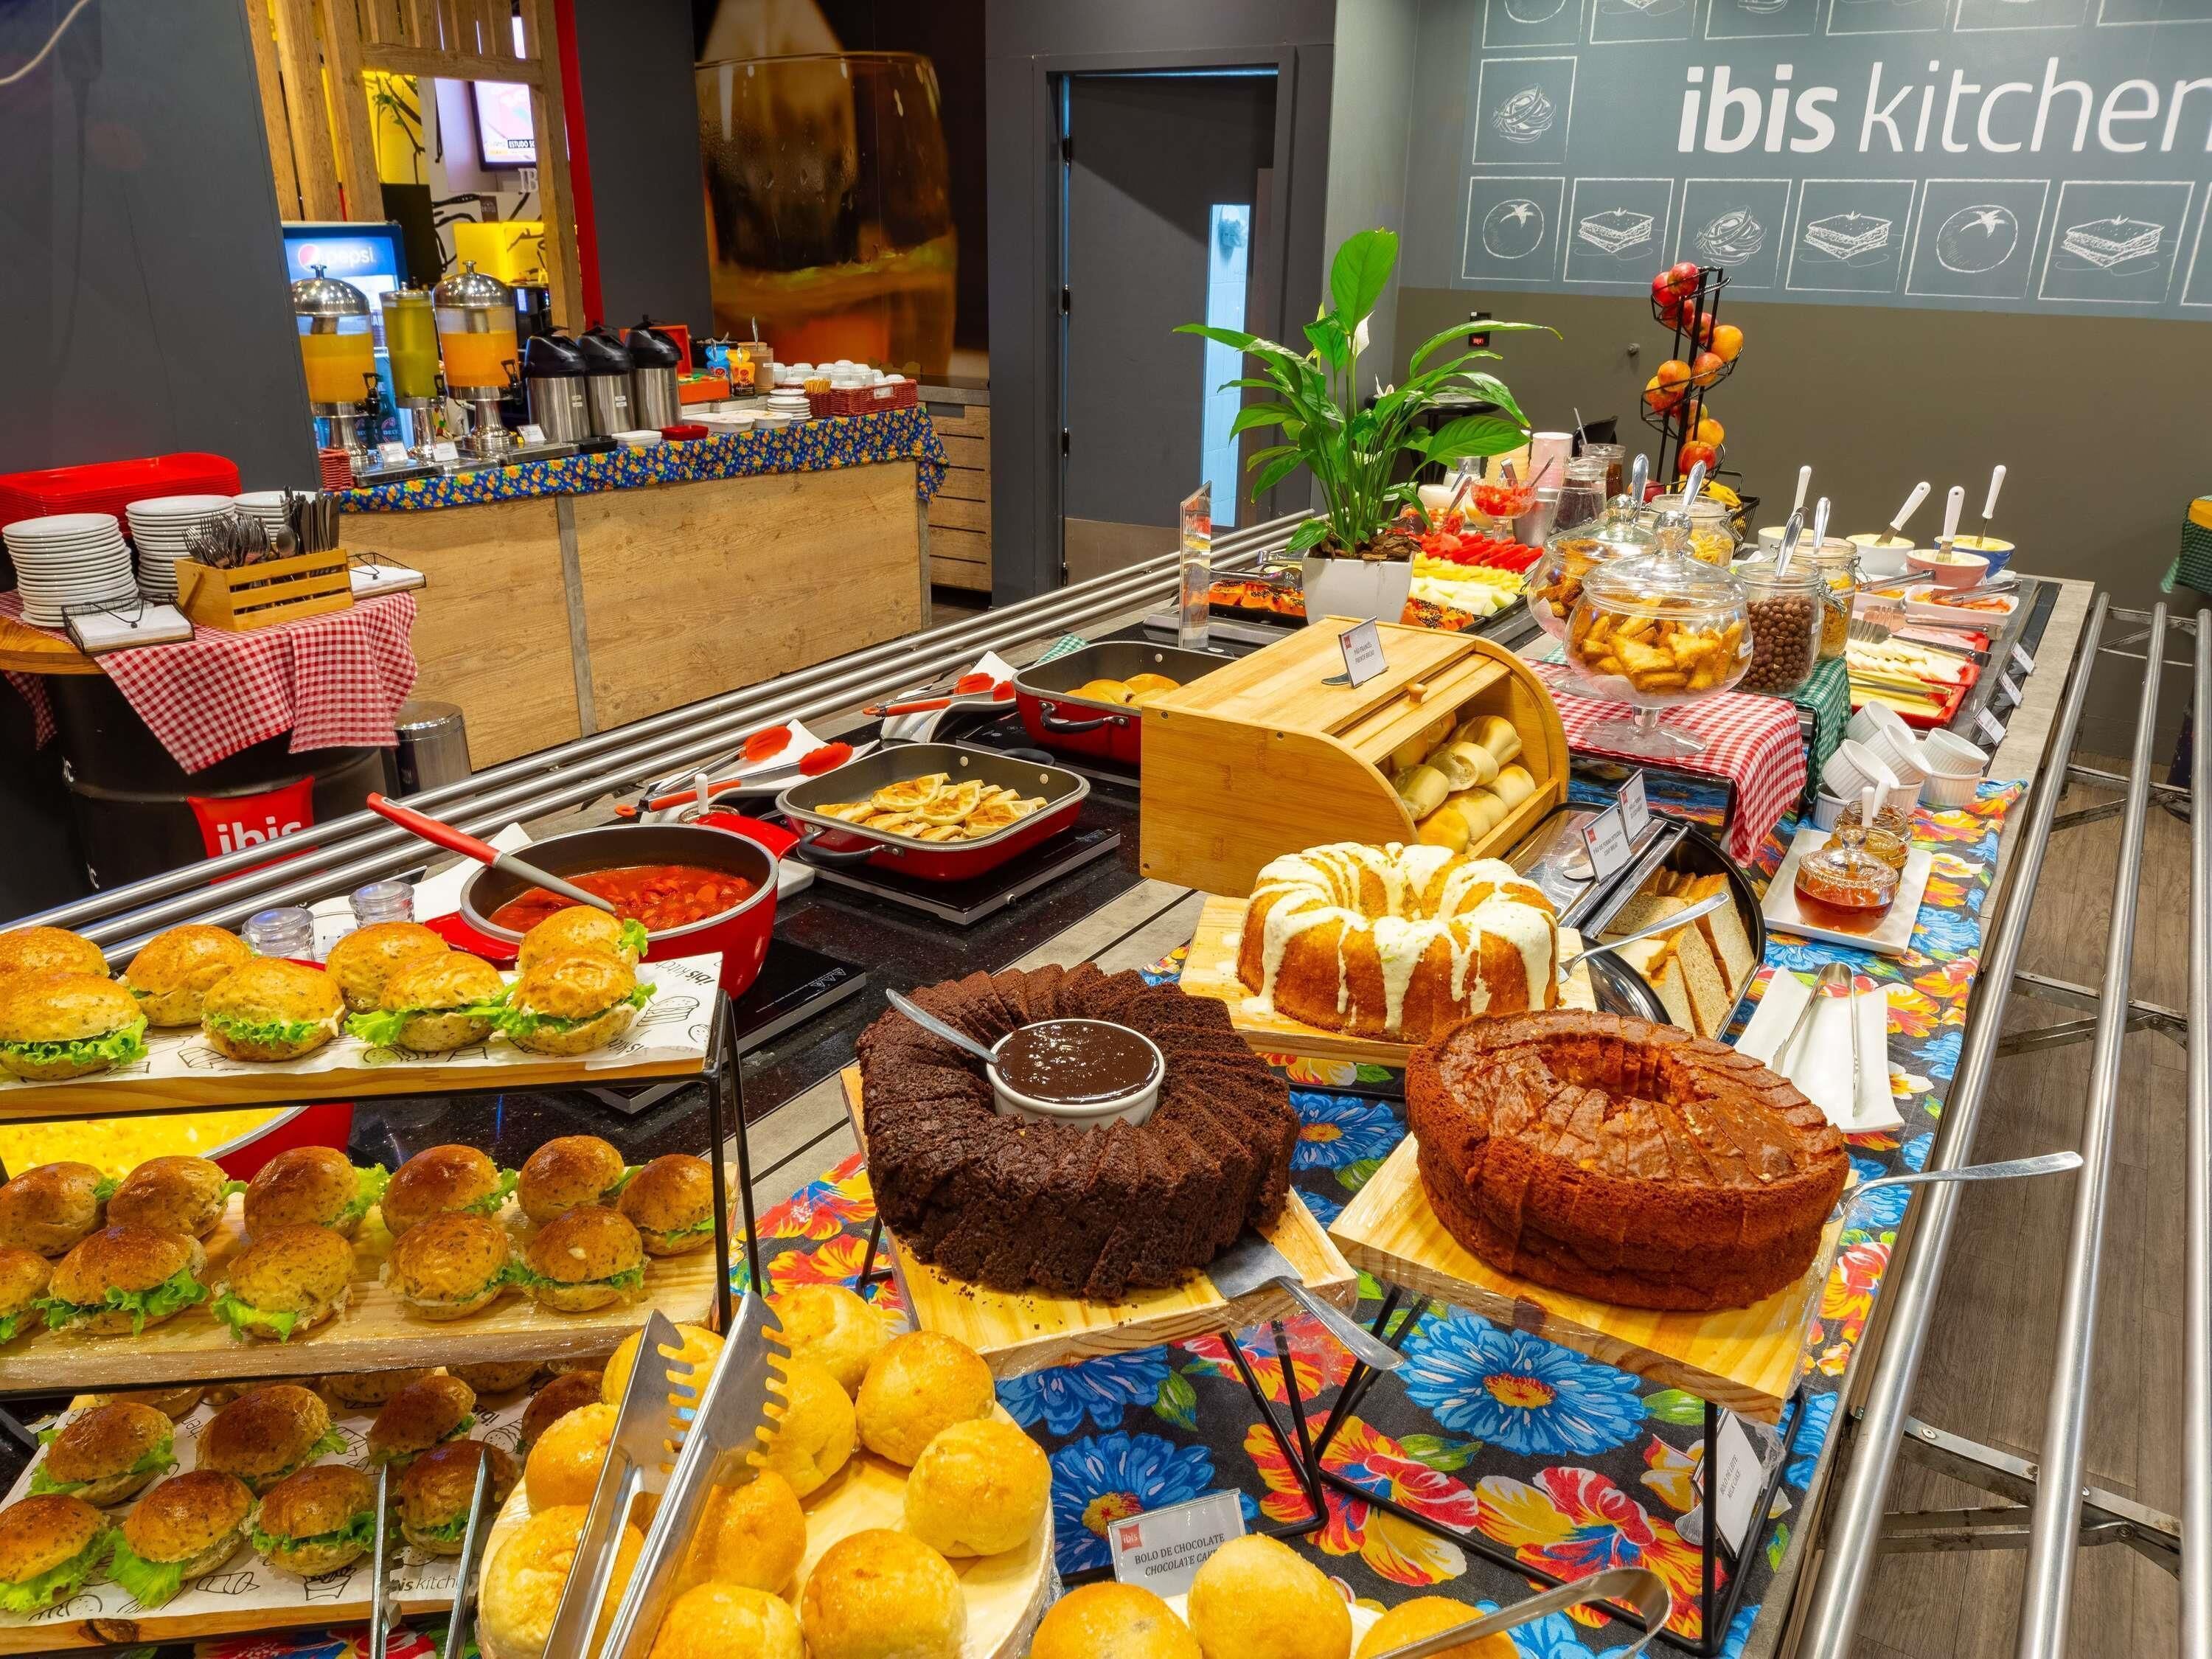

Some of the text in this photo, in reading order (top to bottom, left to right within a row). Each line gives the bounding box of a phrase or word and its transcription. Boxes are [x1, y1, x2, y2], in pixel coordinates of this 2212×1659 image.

[1677, 57, 2212, 153] ibis kitchen
[325, 246, 375, 268] pepsi
[1123, 1533, 1138, 1543] ibis
[1135, 1533, 1225, 1564] BOLO DE CHOCOLATE
[1145, 1555, 1195, 1576] CHOCOLATE
